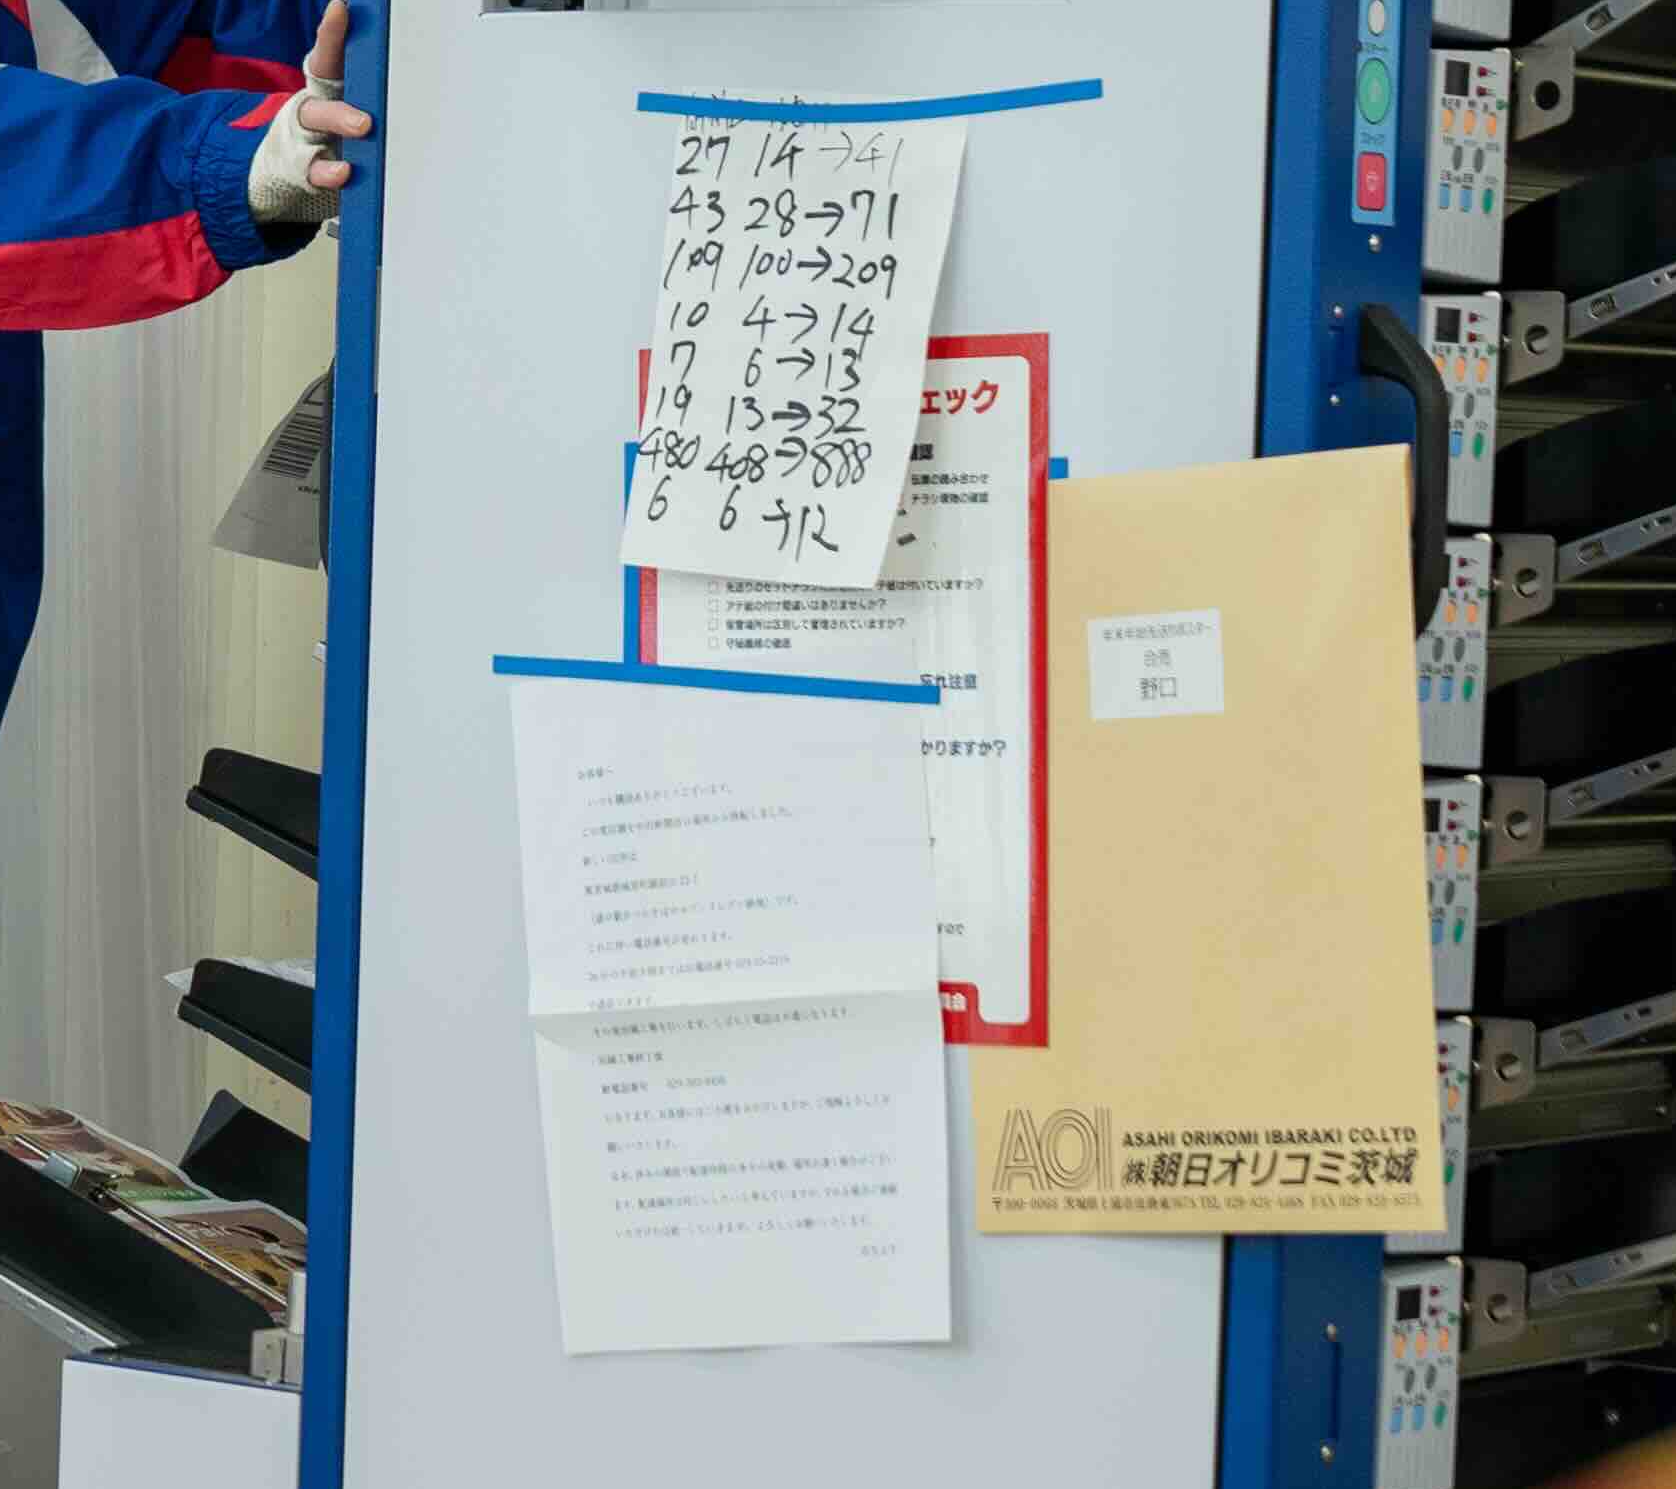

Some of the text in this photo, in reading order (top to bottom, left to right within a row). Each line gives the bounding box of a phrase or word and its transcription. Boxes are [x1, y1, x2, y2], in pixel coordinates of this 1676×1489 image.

[676, 131, 904, 186] 27 14 41
[669, 184, 899, 242] 43 28 71
[738, 243, 794, 291] 100
[831, 253, 898, 301] 209
[669, 294, 875, 362] 10 4 14
[670, 341, 862, 392] 7 6 13
[656, 383, 866, 441] 19 13 32
[704, 441, 770, 485] 408
[809, 437, 873, 490] 888
[647, 474, 840, 563] 6 6 12
[1140, 676, 1178, 701] 野口
[992, 1106, 1113, 1191] AOI
[1123, 1129, 1176, 1148] ASAHI
[1182, 1128, 1259, 1148] ORIKOMI
[1264, 1127, 1343, 1146] IBARAKI
